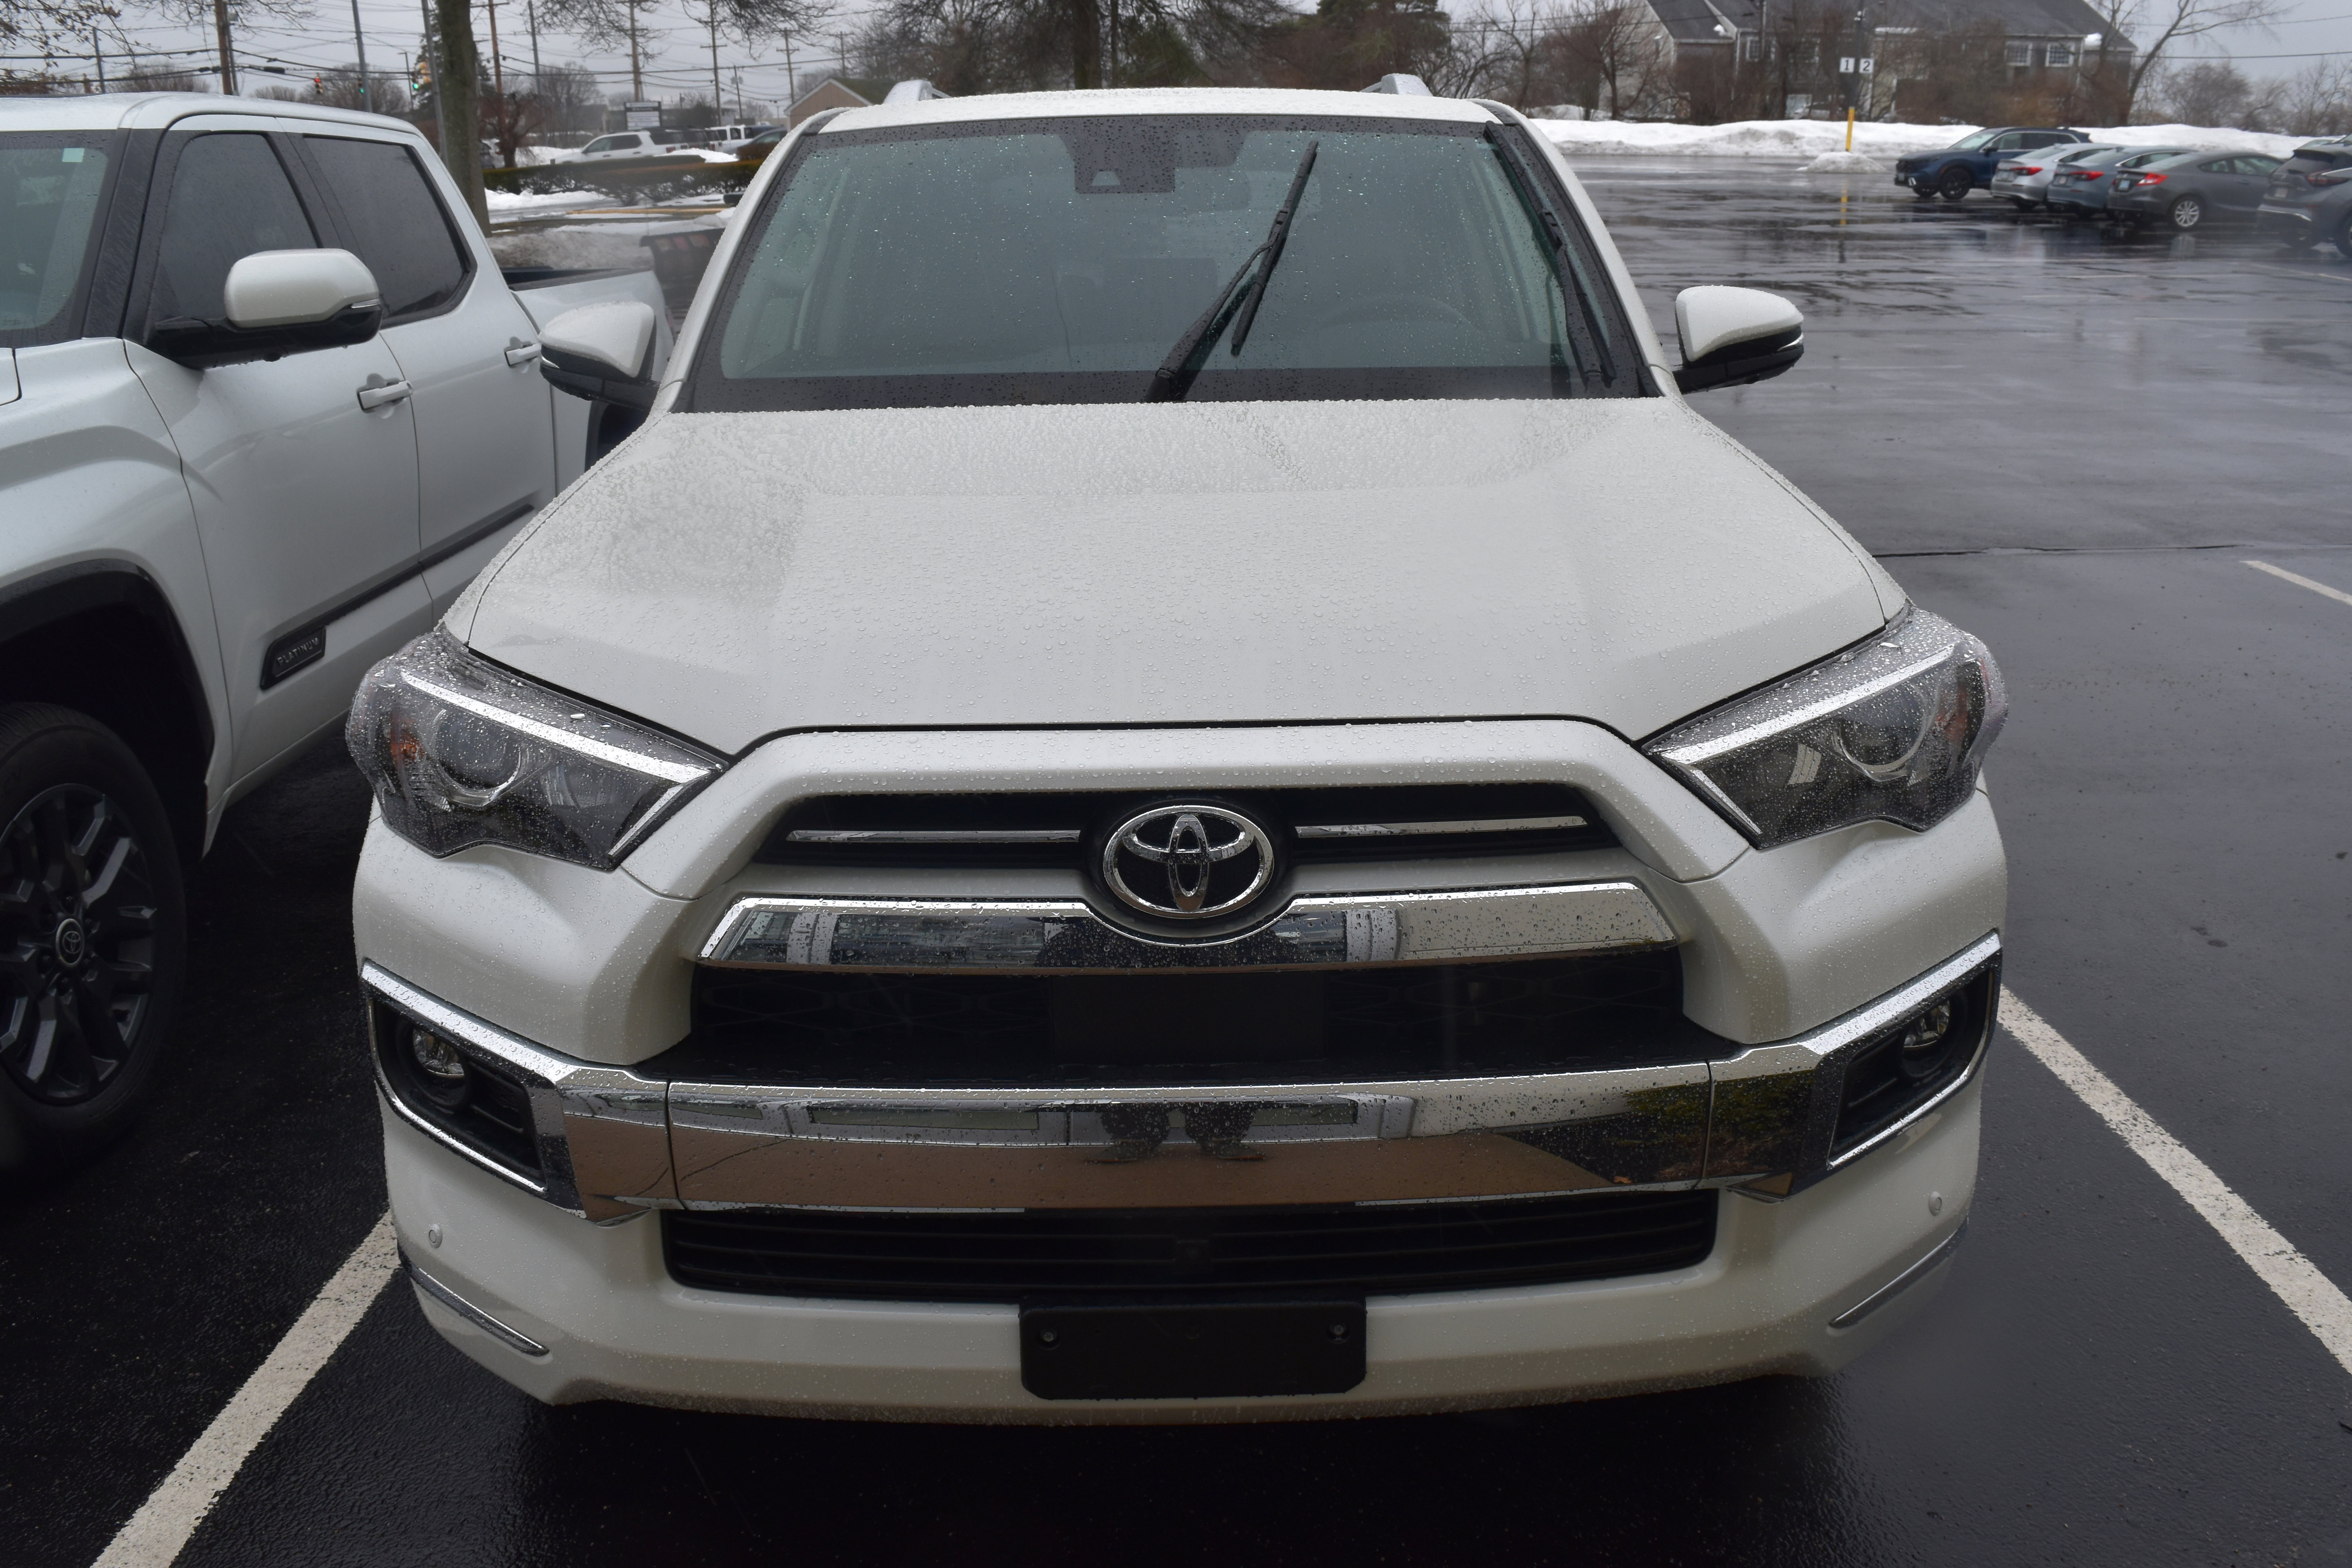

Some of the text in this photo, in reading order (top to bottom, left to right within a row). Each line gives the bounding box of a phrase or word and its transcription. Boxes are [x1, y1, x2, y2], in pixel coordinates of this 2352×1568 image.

[1845, 60, 1849, 70] 1
[1863, 60, 1870, 71] 2
[277, 637, 319, 666] PLATINUM
